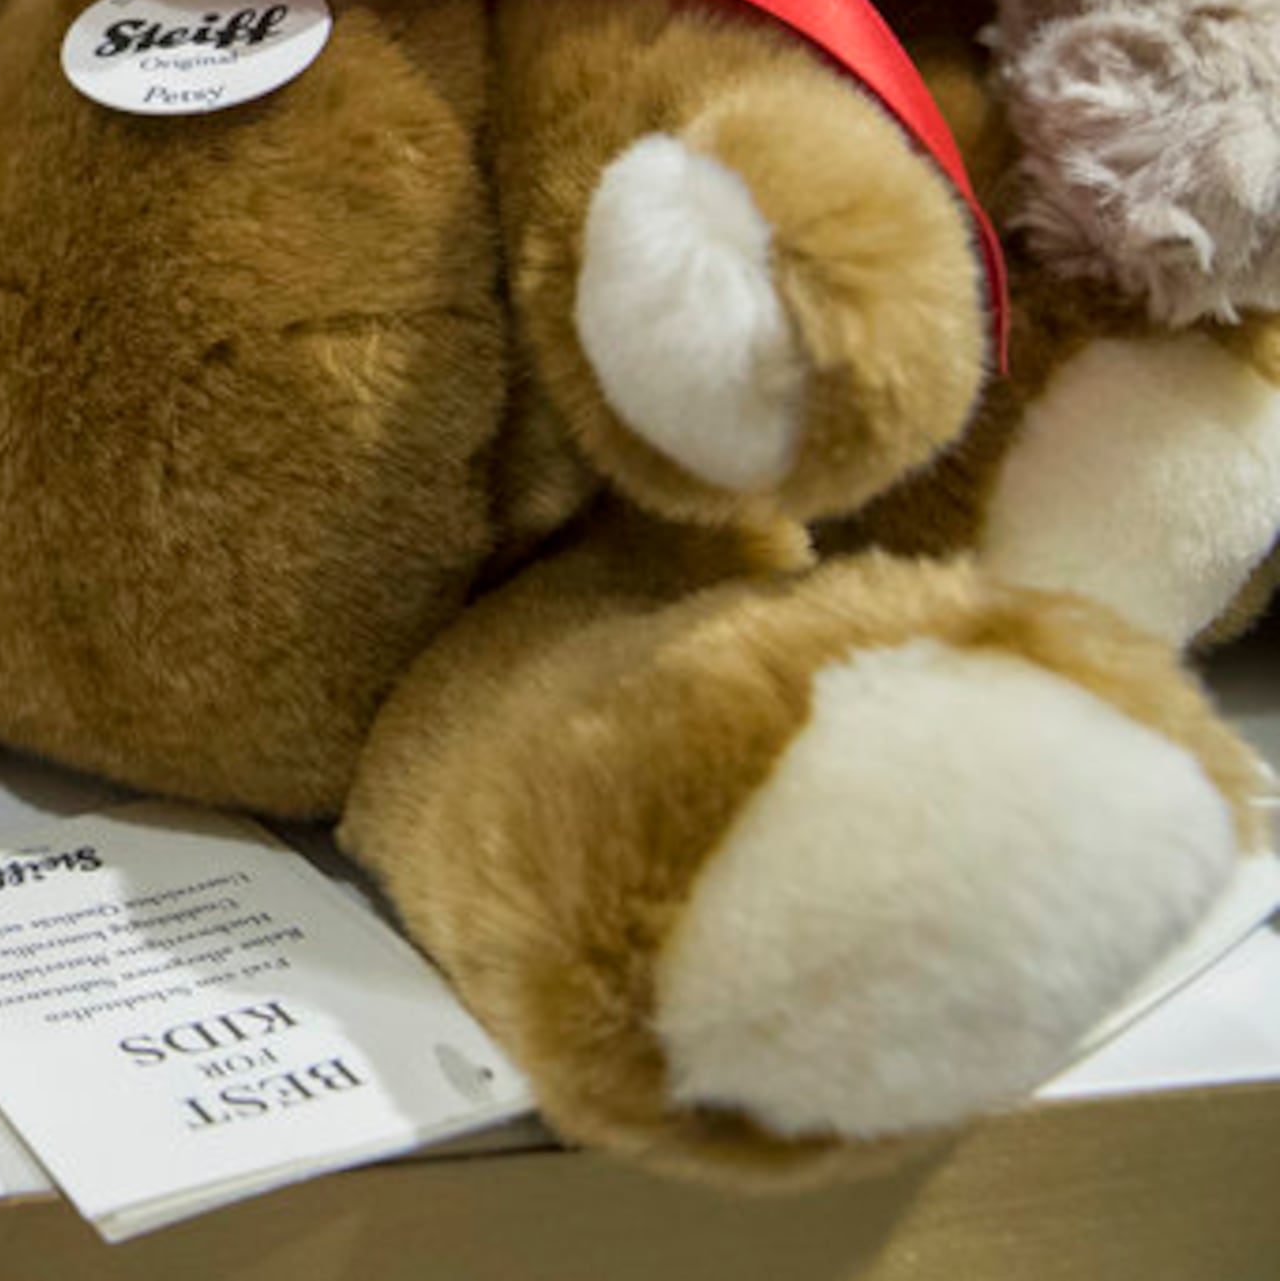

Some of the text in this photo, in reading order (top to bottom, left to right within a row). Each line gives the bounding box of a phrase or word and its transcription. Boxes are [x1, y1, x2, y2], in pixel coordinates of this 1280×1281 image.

[94, 5, 288, 57] Steiff
[119, 1000, 299, 1067] KIDS
[197, 1047, 279, 1080] FOR
[186, 1058, 367, 1133] BEST
